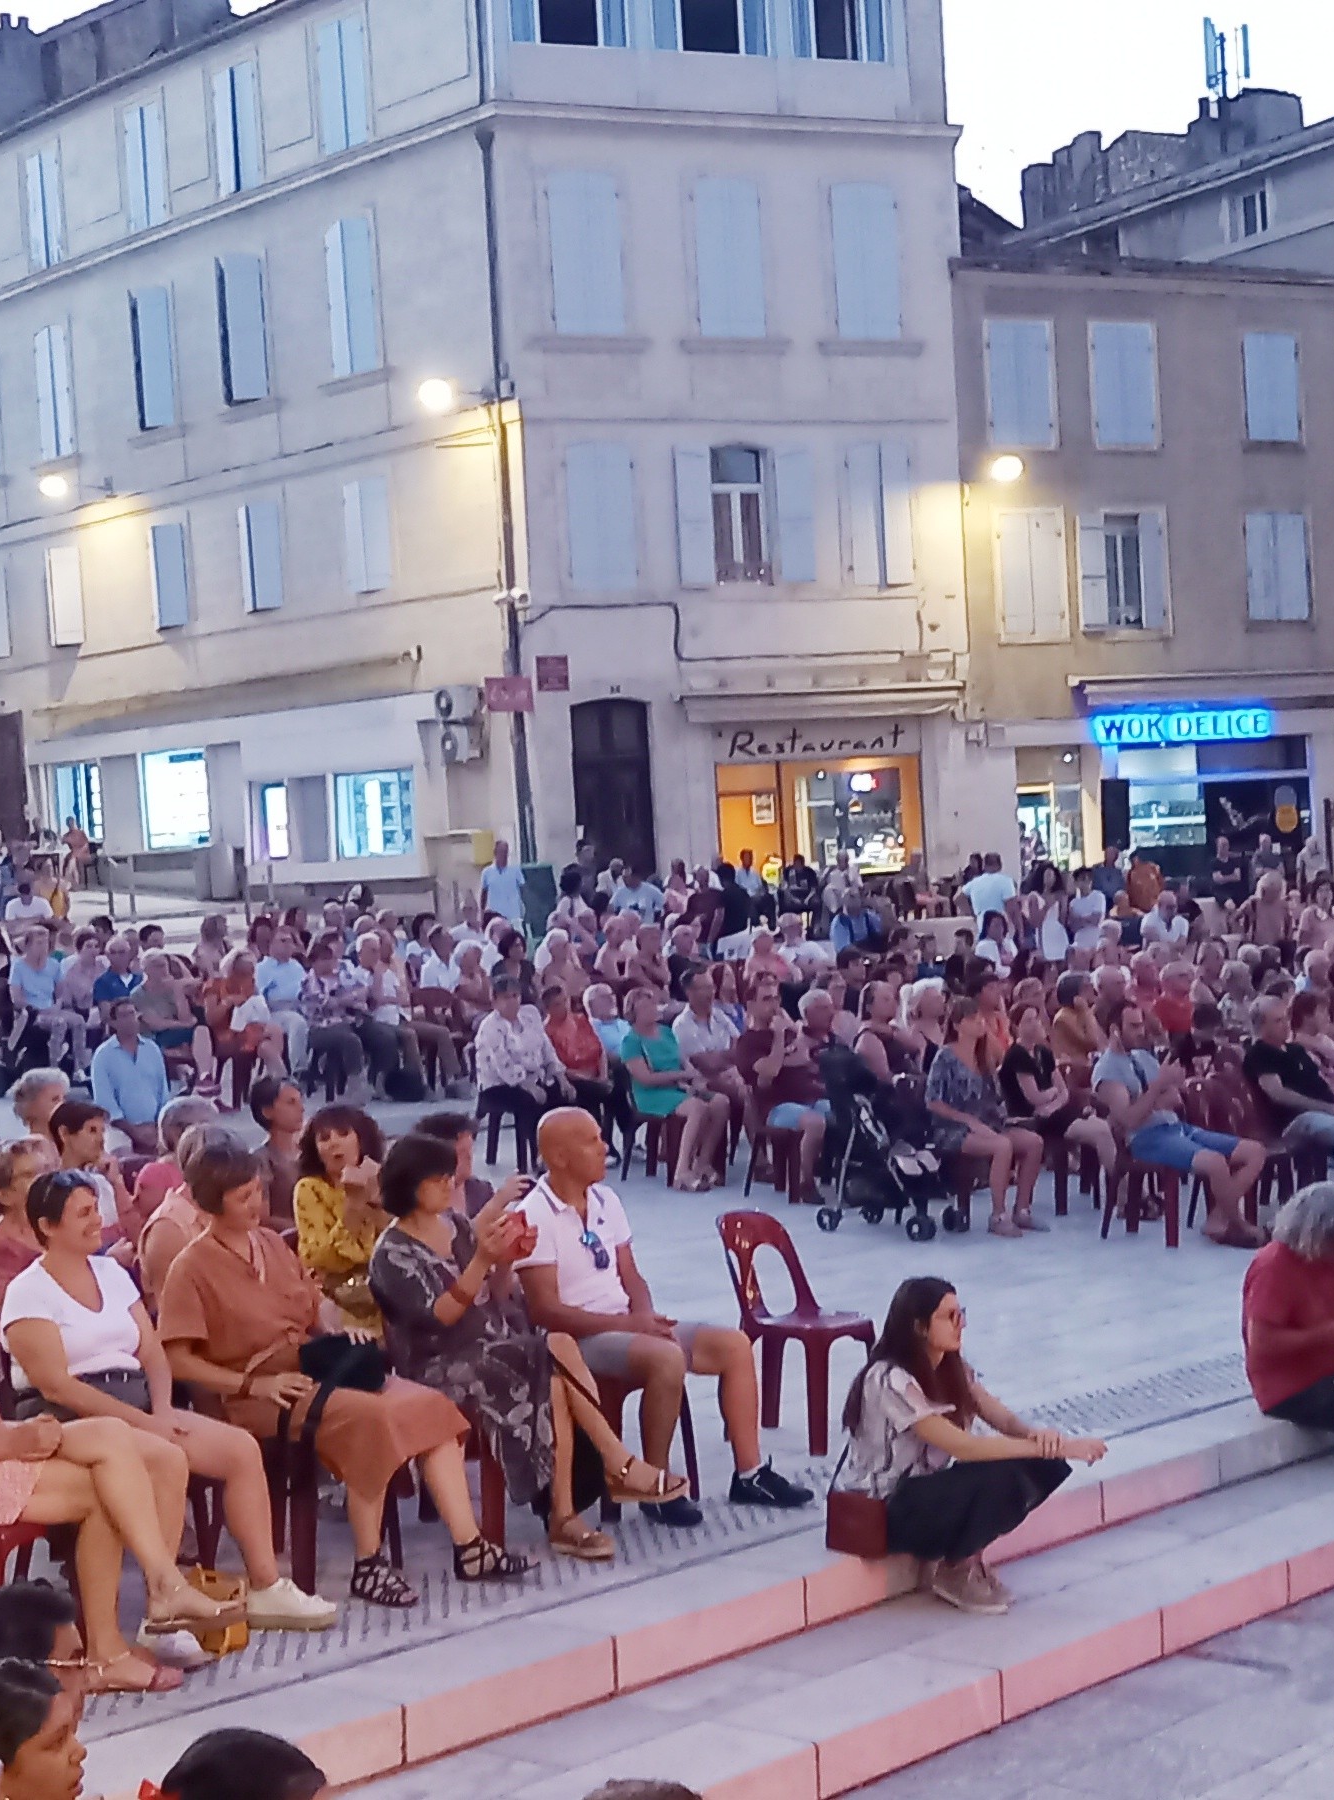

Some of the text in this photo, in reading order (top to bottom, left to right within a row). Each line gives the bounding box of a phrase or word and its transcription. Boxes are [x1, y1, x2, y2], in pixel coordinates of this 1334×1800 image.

[727, 723, 905, 758] Restaurant
[1101, 712, 1268, 741] WOK DELICE
